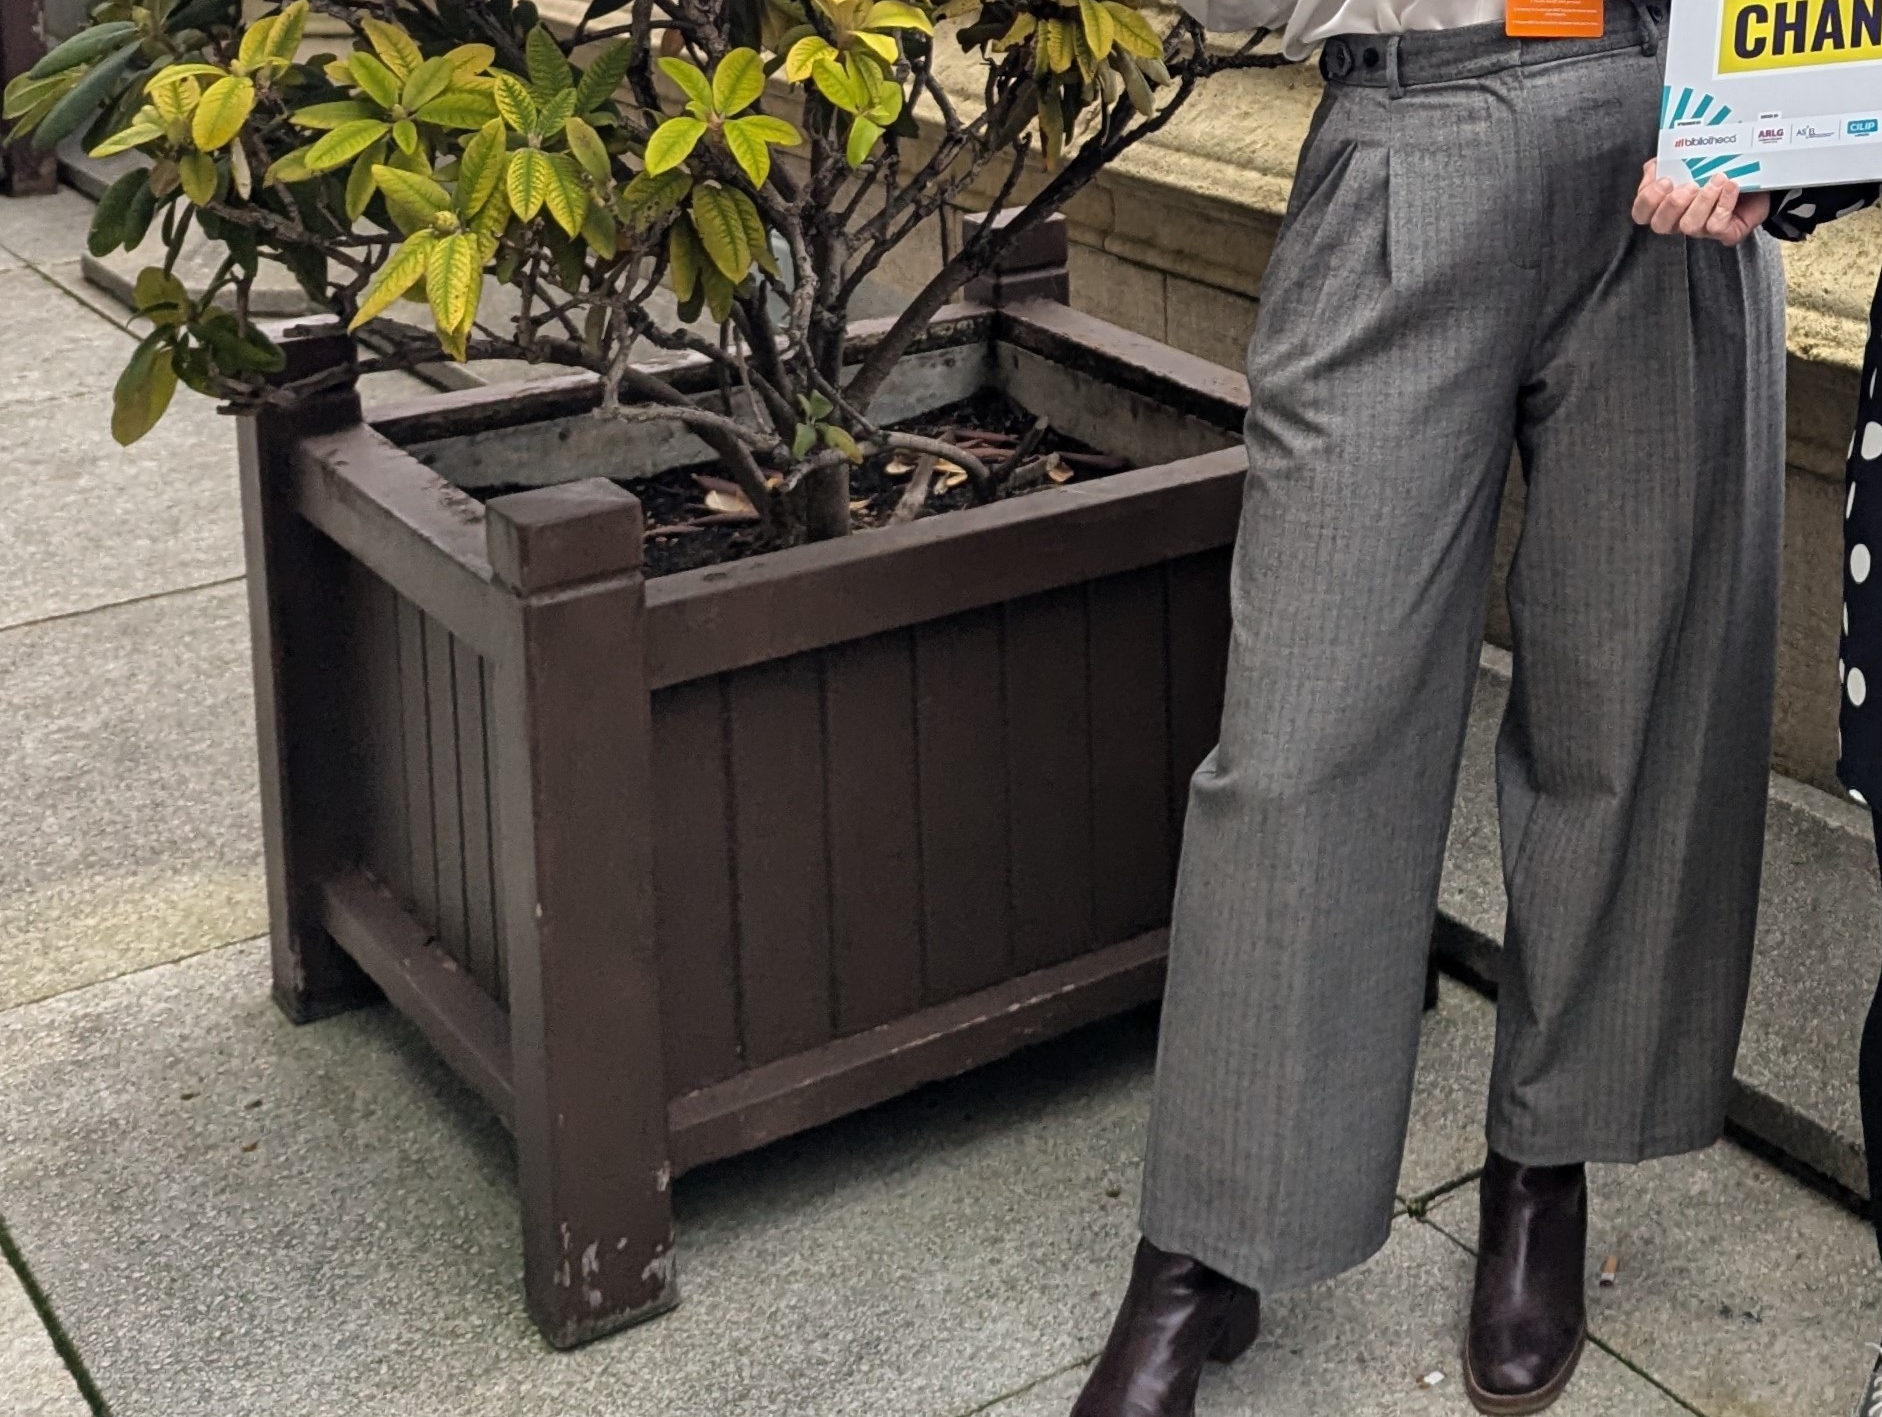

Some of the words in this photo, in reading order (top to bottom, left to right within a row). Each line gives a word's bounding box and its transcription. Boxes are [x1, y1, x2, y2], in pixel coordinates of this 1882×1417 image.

[1849, 122, 1876, 132] CILIP
[1758, 129, 1784, 139] ARLG
[1685, 134, 1736, 147] bibliotheca
